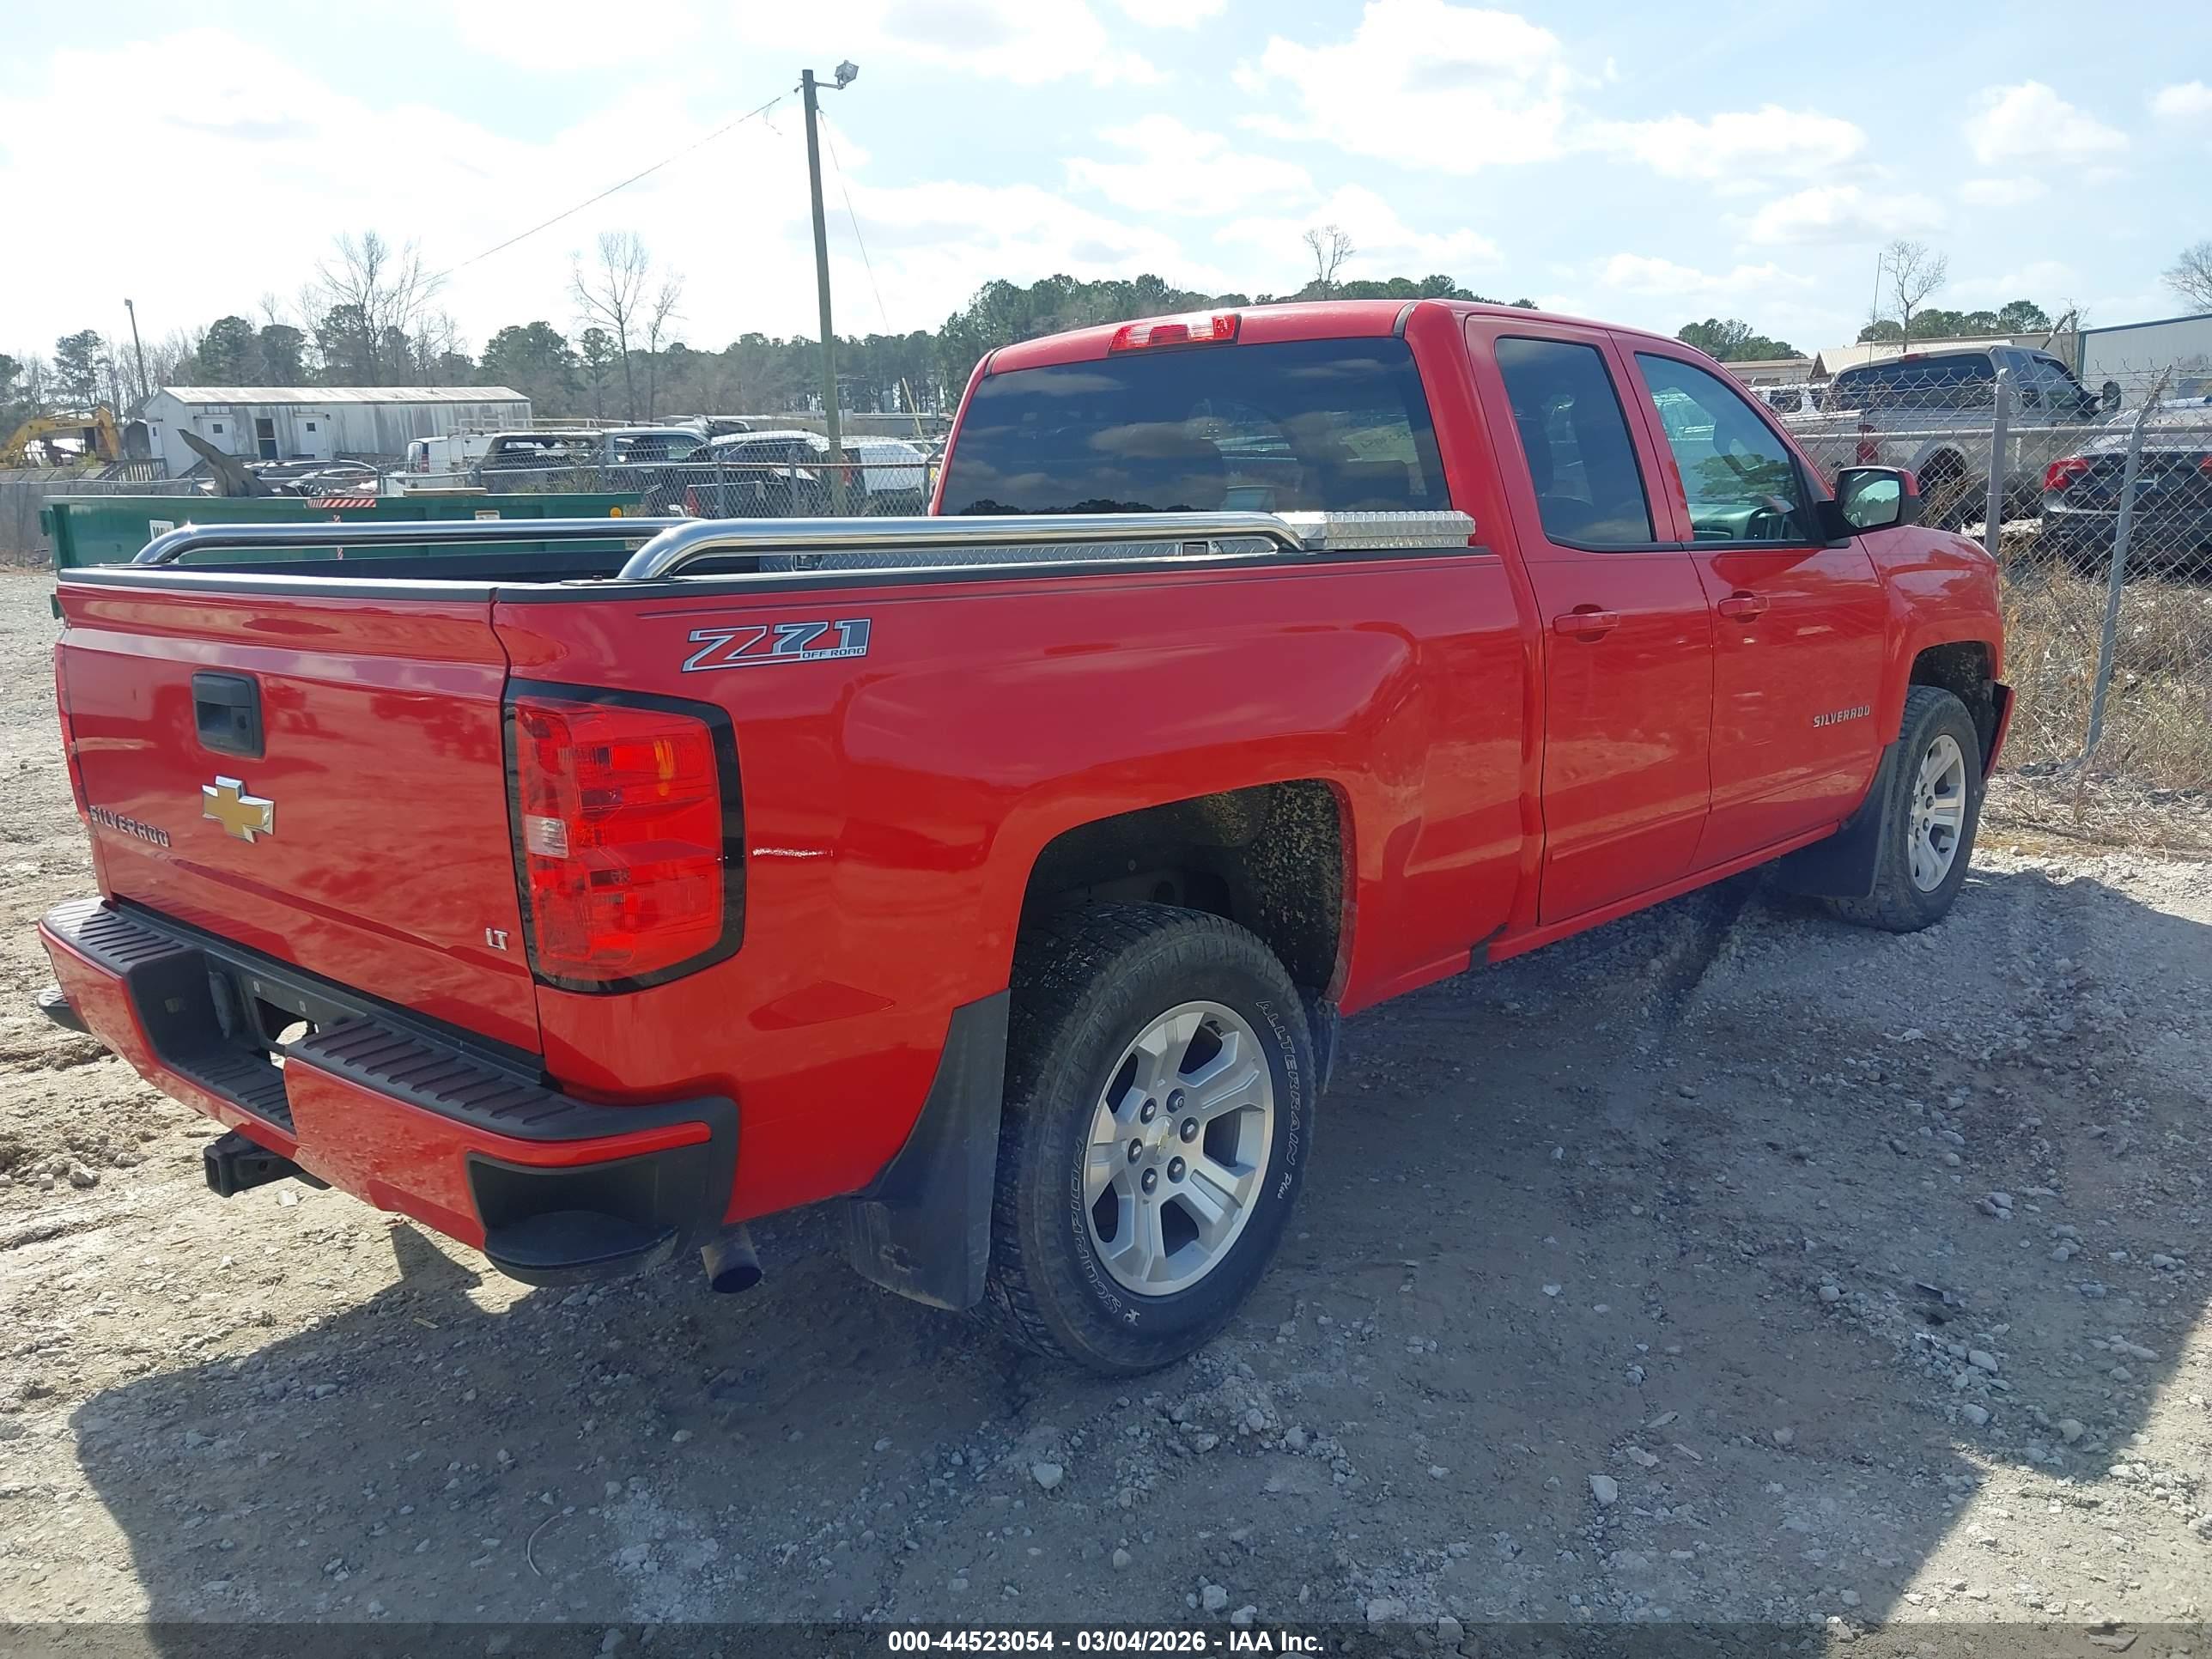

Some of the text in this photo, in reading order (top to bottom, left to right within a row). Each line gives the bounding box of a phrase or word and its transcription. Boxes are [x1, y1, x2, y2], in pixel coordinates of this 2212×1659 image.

[681, 618, 872, 672] Z71
[802, 647, 866, 659] OFF ROAD
[1814, 705, 1870, 728] SILVERADO
[89, 805, 169, 848] SILVERADO
[485, 927, 508, 951] LT
